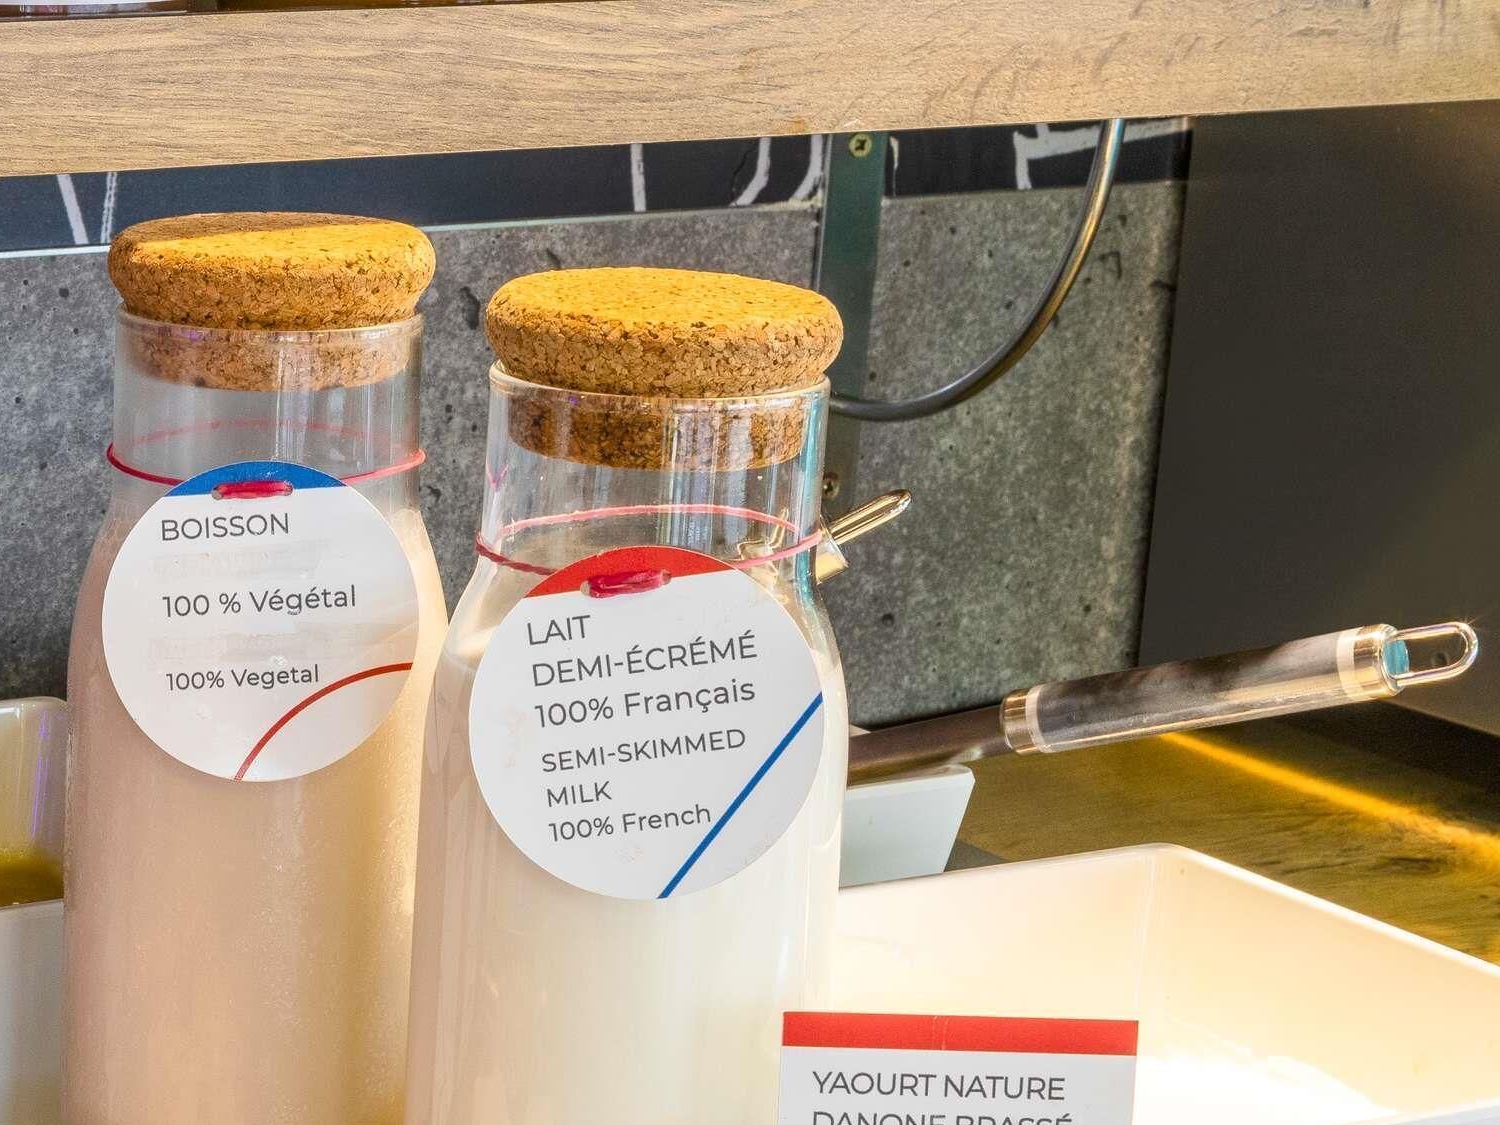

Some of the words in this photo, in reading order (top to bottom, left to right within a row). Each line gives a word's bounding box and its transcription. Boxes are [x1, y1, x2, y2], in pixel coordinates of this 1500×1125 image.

[161, 513, 289, 541] BOISSON
[162, 595, 210, 618] 100
[219, 593, 241, 614] %
[249, 585, 356, 615] Végétal
[527, 614, 591, 646] LAIT
[532, 630, 758, 686] DEMI-ÉCRÉMÉ
[166, 671, 224, 691] 100%
[231, 664, 319, 690] Vegetal
[535, 697, 613, 728] 100%
[624, 678, 755, 717] Français
[542, 728, 746, 772] SEMI-SKIMMED
[547, 781, 612, 808] MILK
[549, 817, 614, 842] 100%
[622, 804, 711, 834] French
[812, 1070, 936, 1097] YAOURT
[944, 1075, 1066, 1100] NATURE
